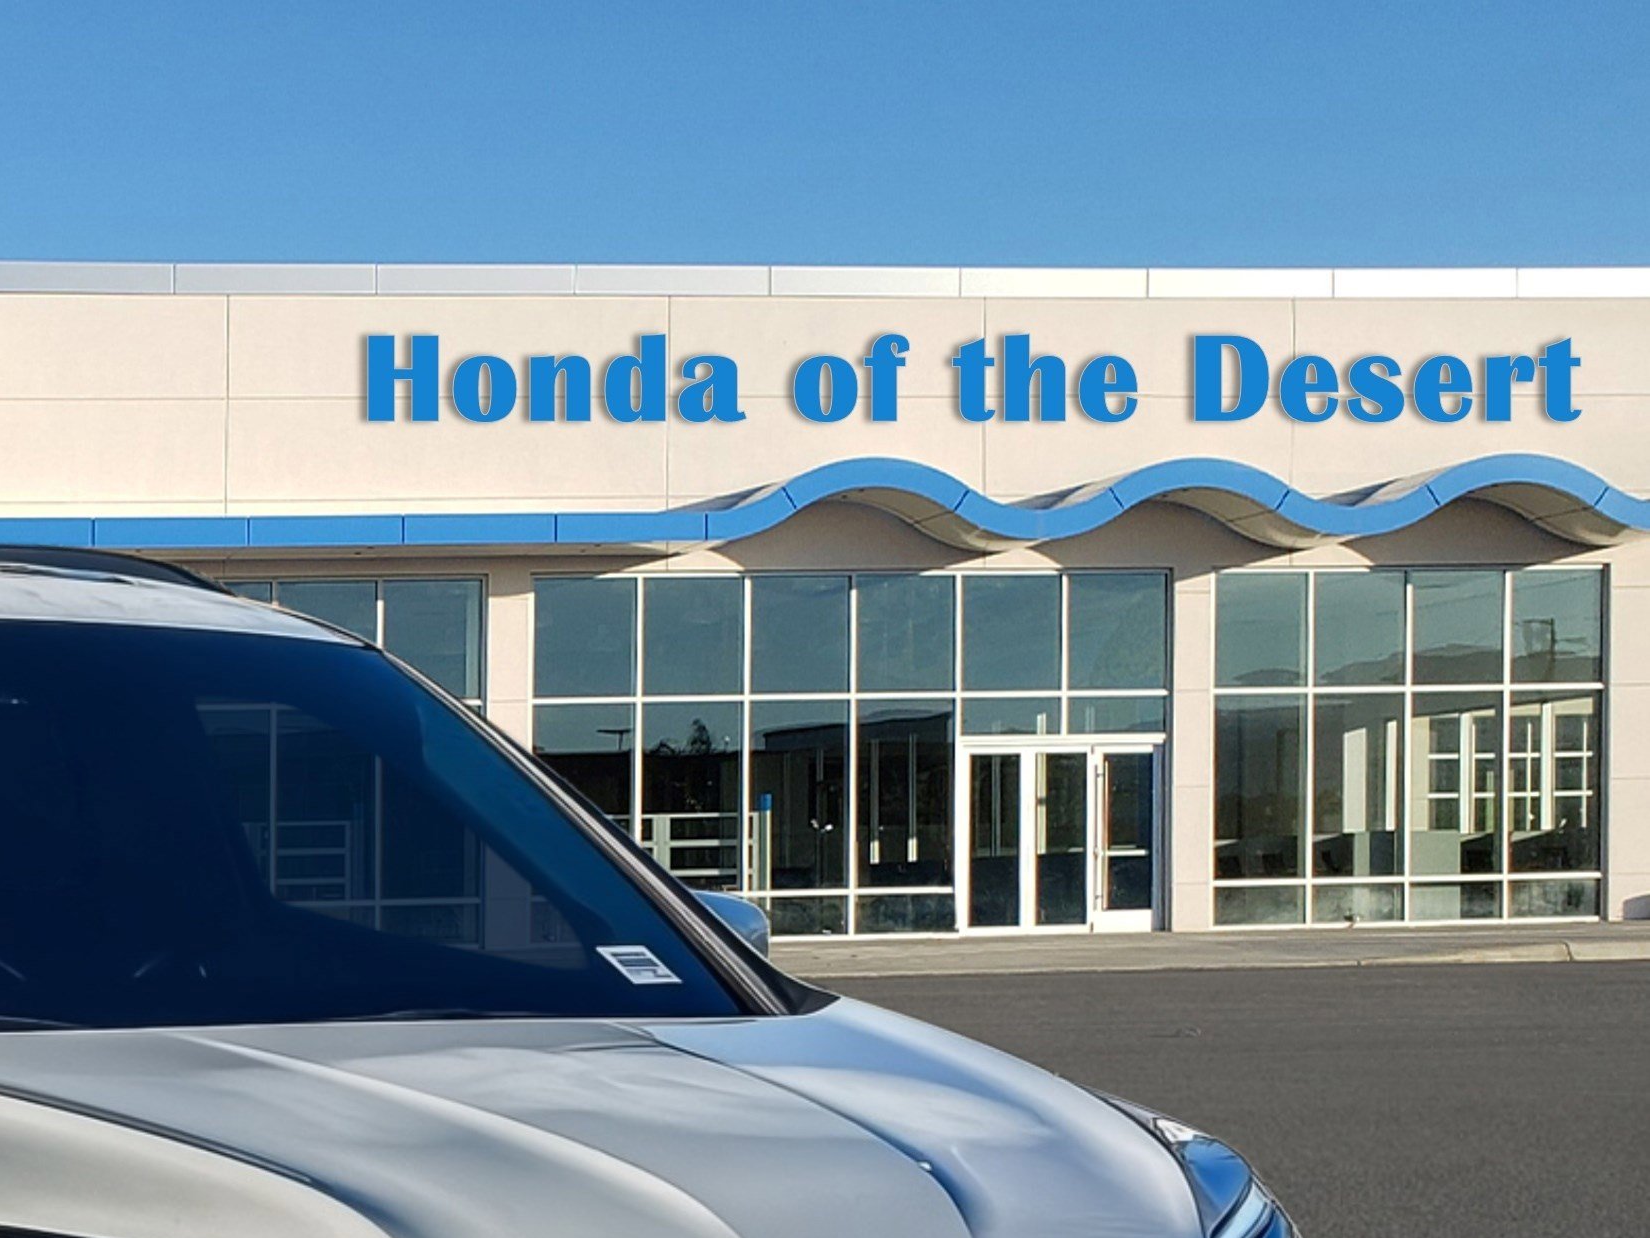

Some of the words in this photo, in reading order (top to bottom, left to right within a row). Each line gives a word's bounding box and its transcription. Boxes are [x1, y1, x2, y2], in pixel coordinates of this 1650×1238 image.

[366, 332, 747, 424] Honda
[792, 332, 911, 424] of
[951, 332, 1139, 424] the
[1193, 333, 1583, 424] Desert
